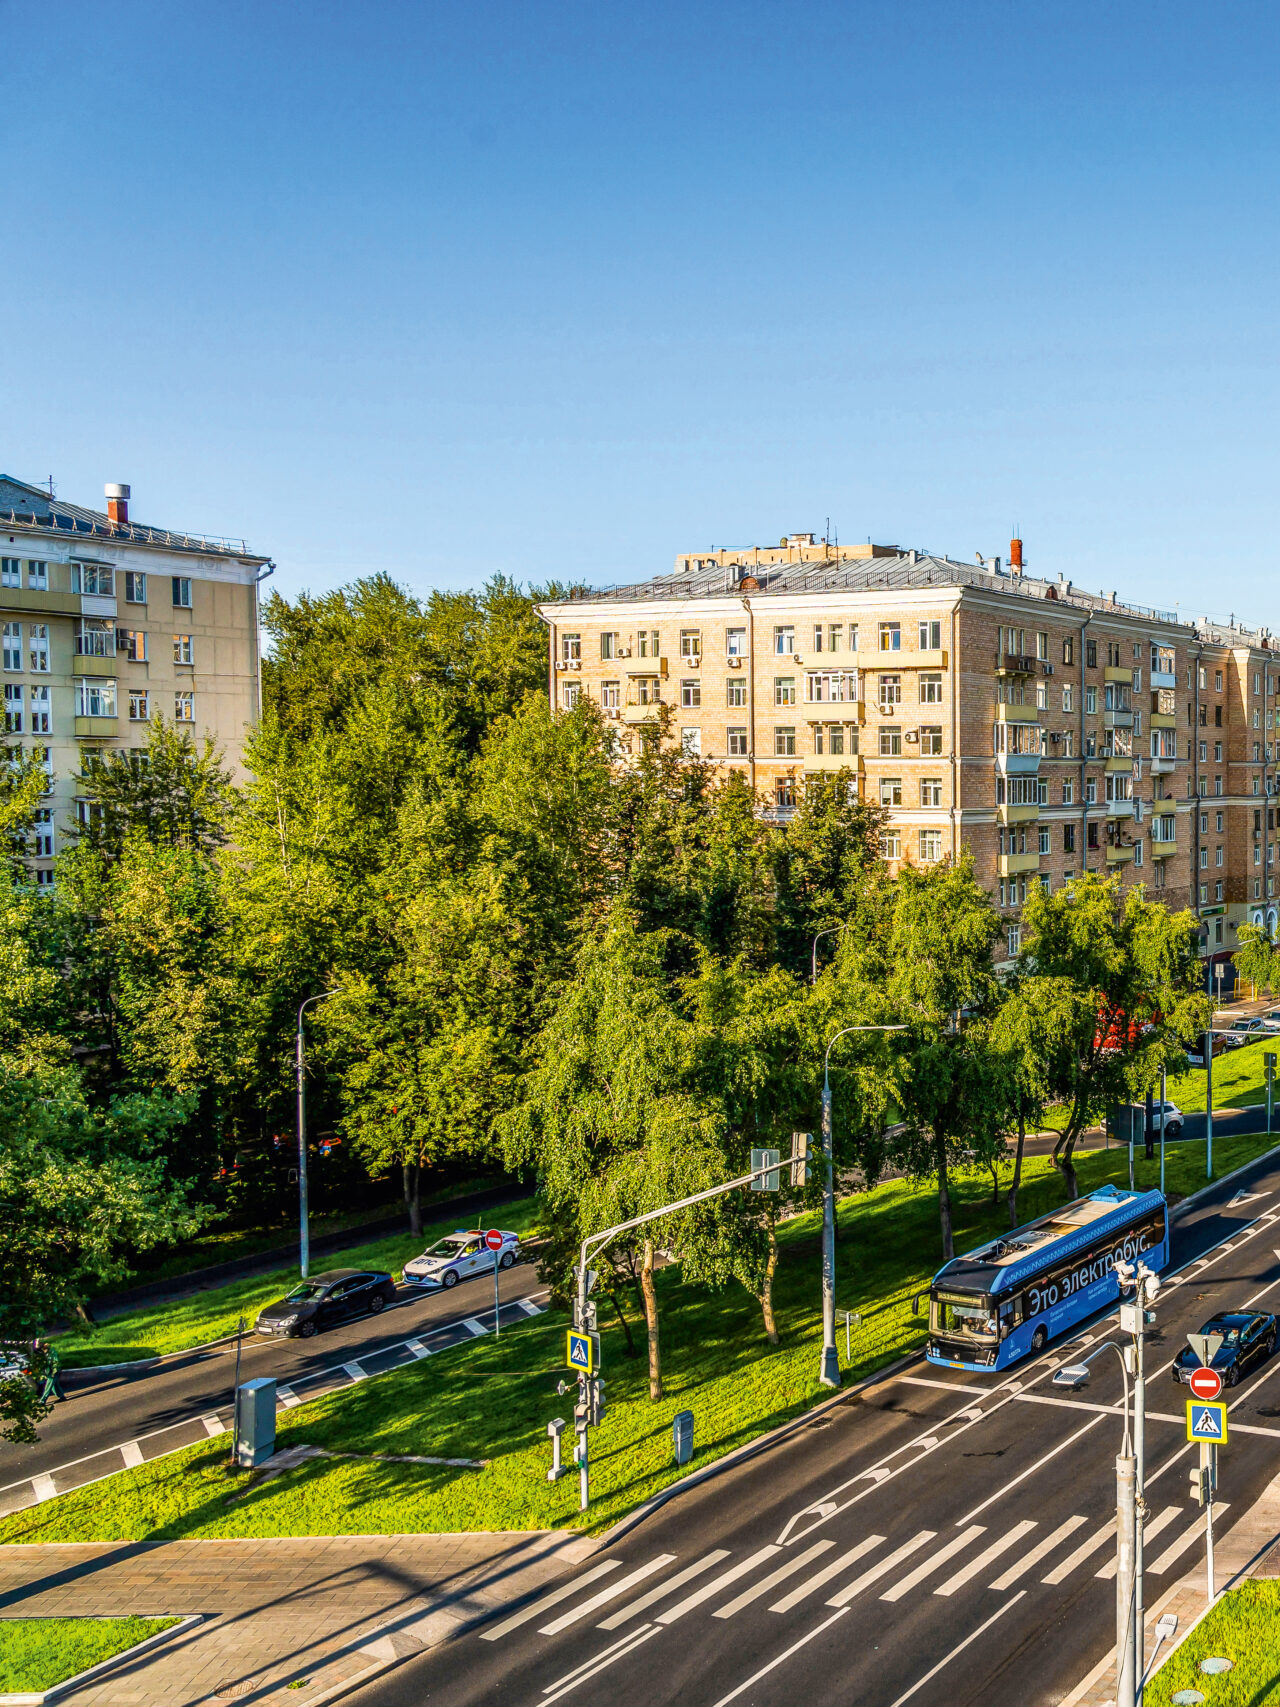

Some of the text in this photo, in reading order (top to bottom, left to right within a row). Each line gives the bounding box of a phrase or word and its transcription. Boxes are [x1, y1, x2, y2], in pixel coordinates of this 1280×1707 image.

[411, 1258, 438, 1266] ДПС
[1028, 1282, 1059, 1317] Это
[1061, 1233, 1151, 1299] электробус.
